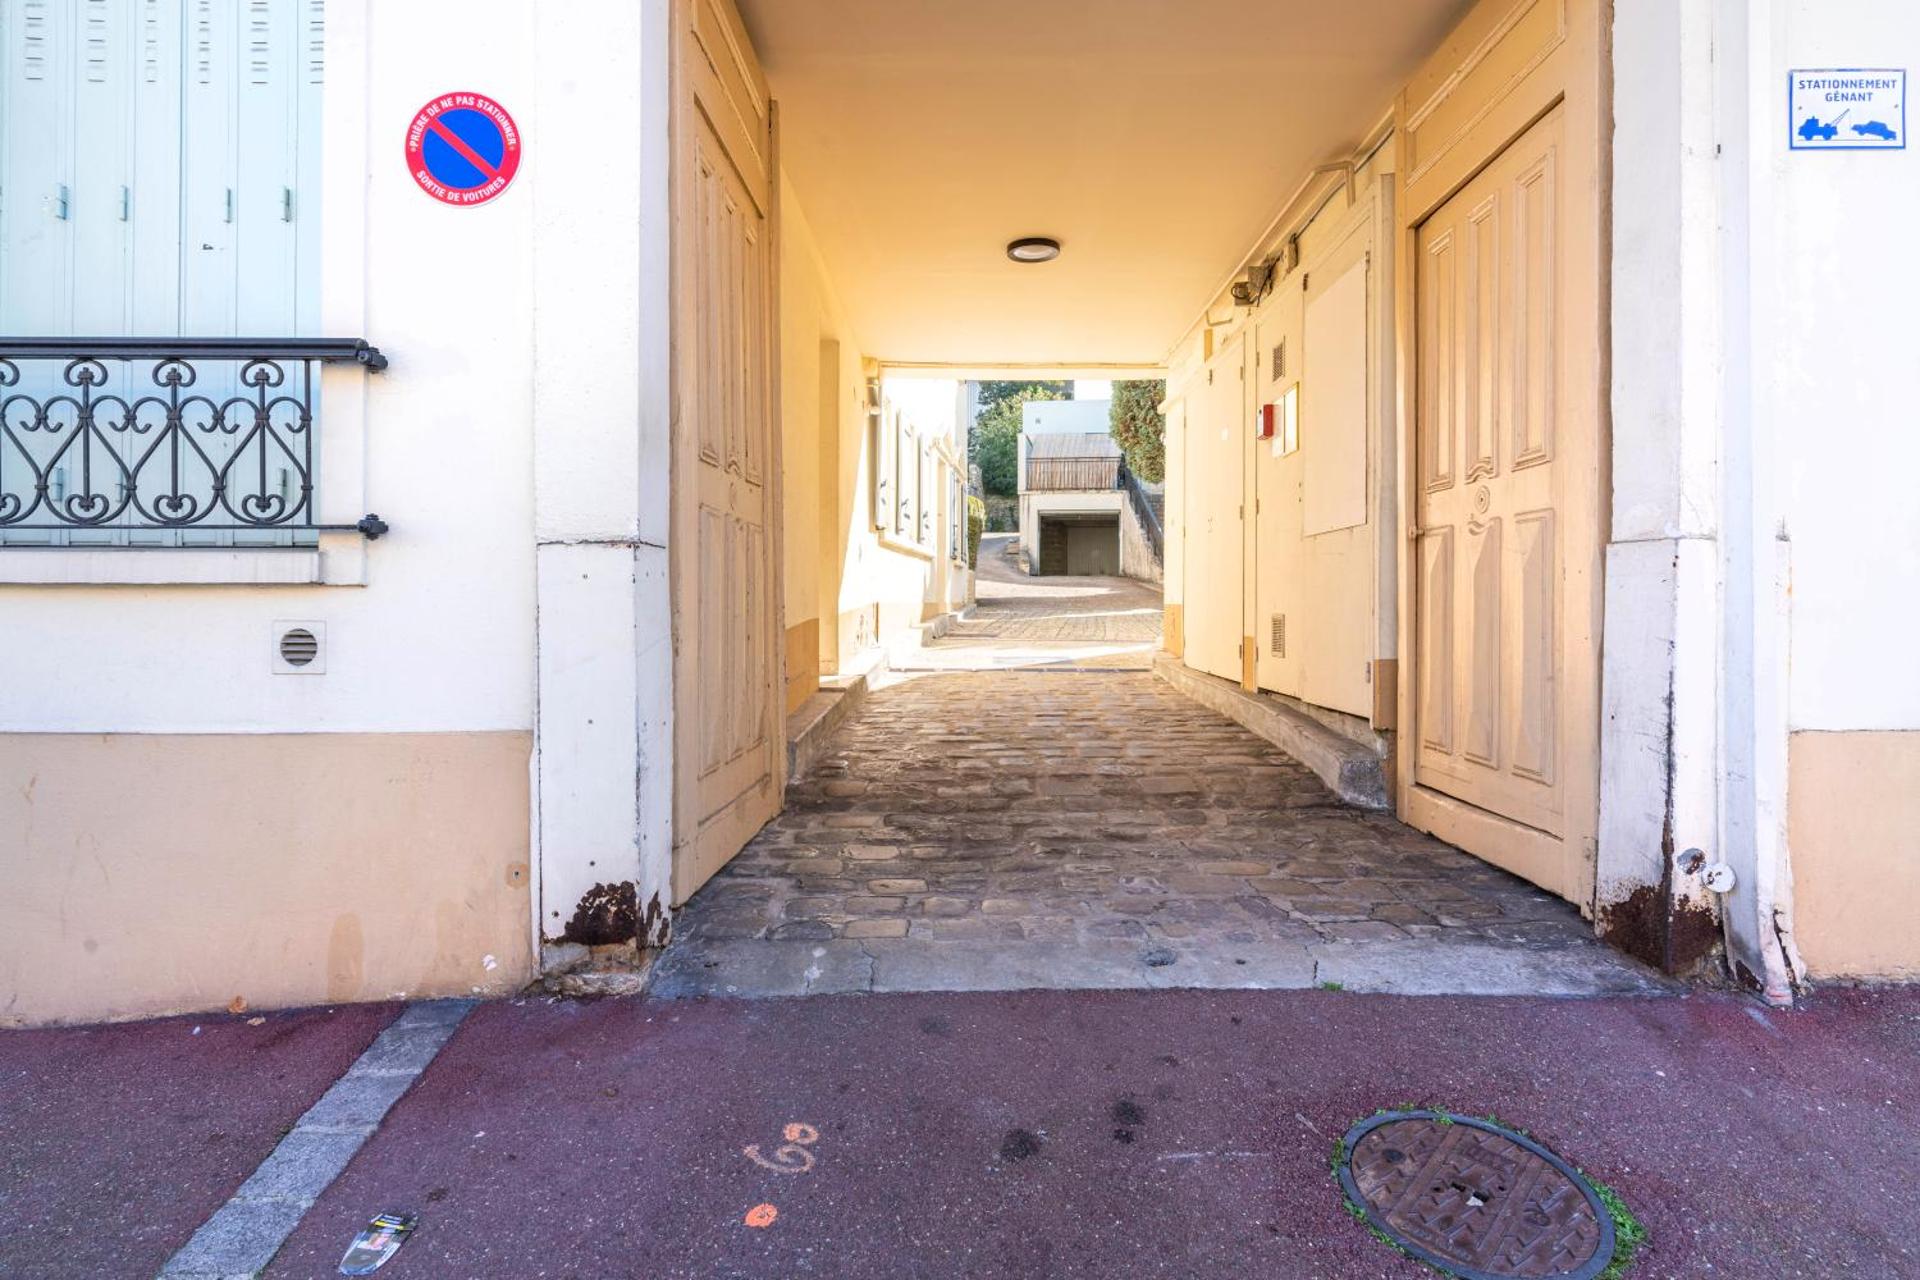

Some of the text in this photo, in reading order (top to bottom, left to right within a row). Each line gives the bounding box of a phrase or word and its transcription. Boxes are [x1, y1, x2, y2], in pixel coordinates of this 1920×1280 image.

[1799, 79, 1897, 89] STATIONNEMENT
[426, 103, 441, 117] DE
[440, 97, 454, 109] NE
[456, 95, 475, 106] PAS
[476, 99, 517, 145] STATIONNER
[416, 170, 506, 202] SORTIE DE VOITURES
